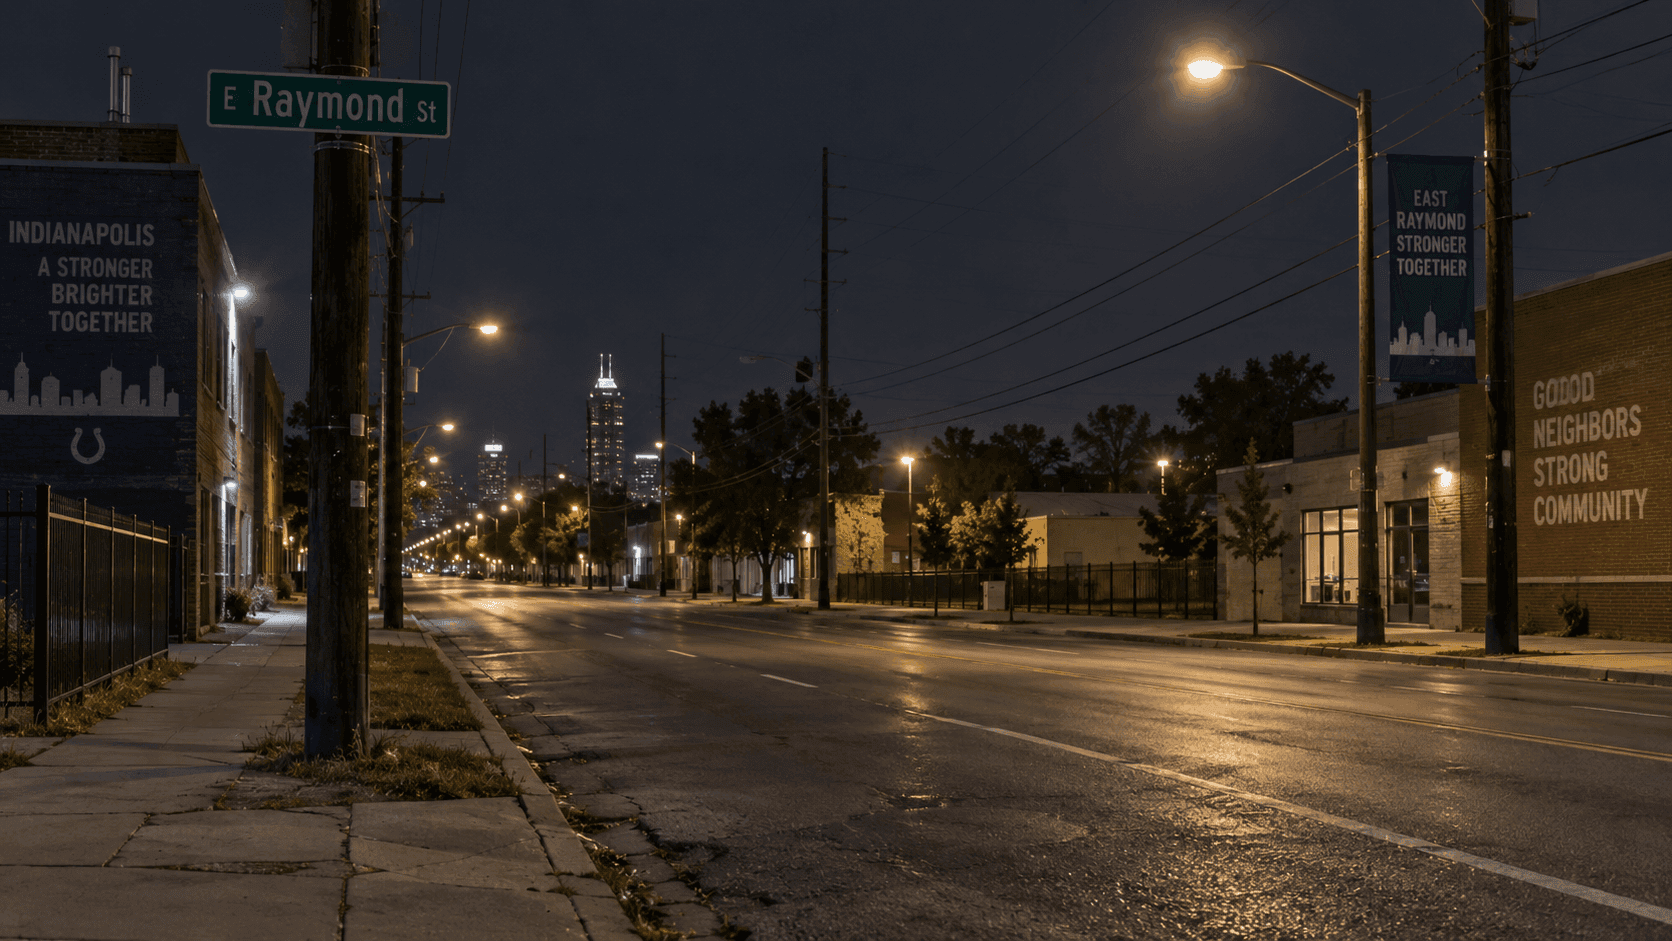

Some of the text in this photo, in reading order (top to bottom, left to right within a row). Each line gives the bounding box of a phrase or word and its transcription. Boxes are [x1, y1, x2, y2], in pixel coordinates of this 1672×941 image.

[223, 80, 437, 128] E Raymond St
[1413, 189, 1448, 208] EAST
[1396, 211, 1466, 231] RAYMOND
[8, 220, 155, 247] INDIANAPOLIS
[1396, 234, 1467, 254] STRONGER
[37, 256, 153, 279] A STRONGER
[1396, 257, 1467, 277] TOGETHER
[51, 282, 153, 306] BRIGHTER
[48, 310, 153, 334] TOGETHER
[1533, 404, 1642, 449] NEIGHBORS
[1533, 450, 1609, 487] STRONG
[1533, 487, 1648, 526] COMMUNITY
